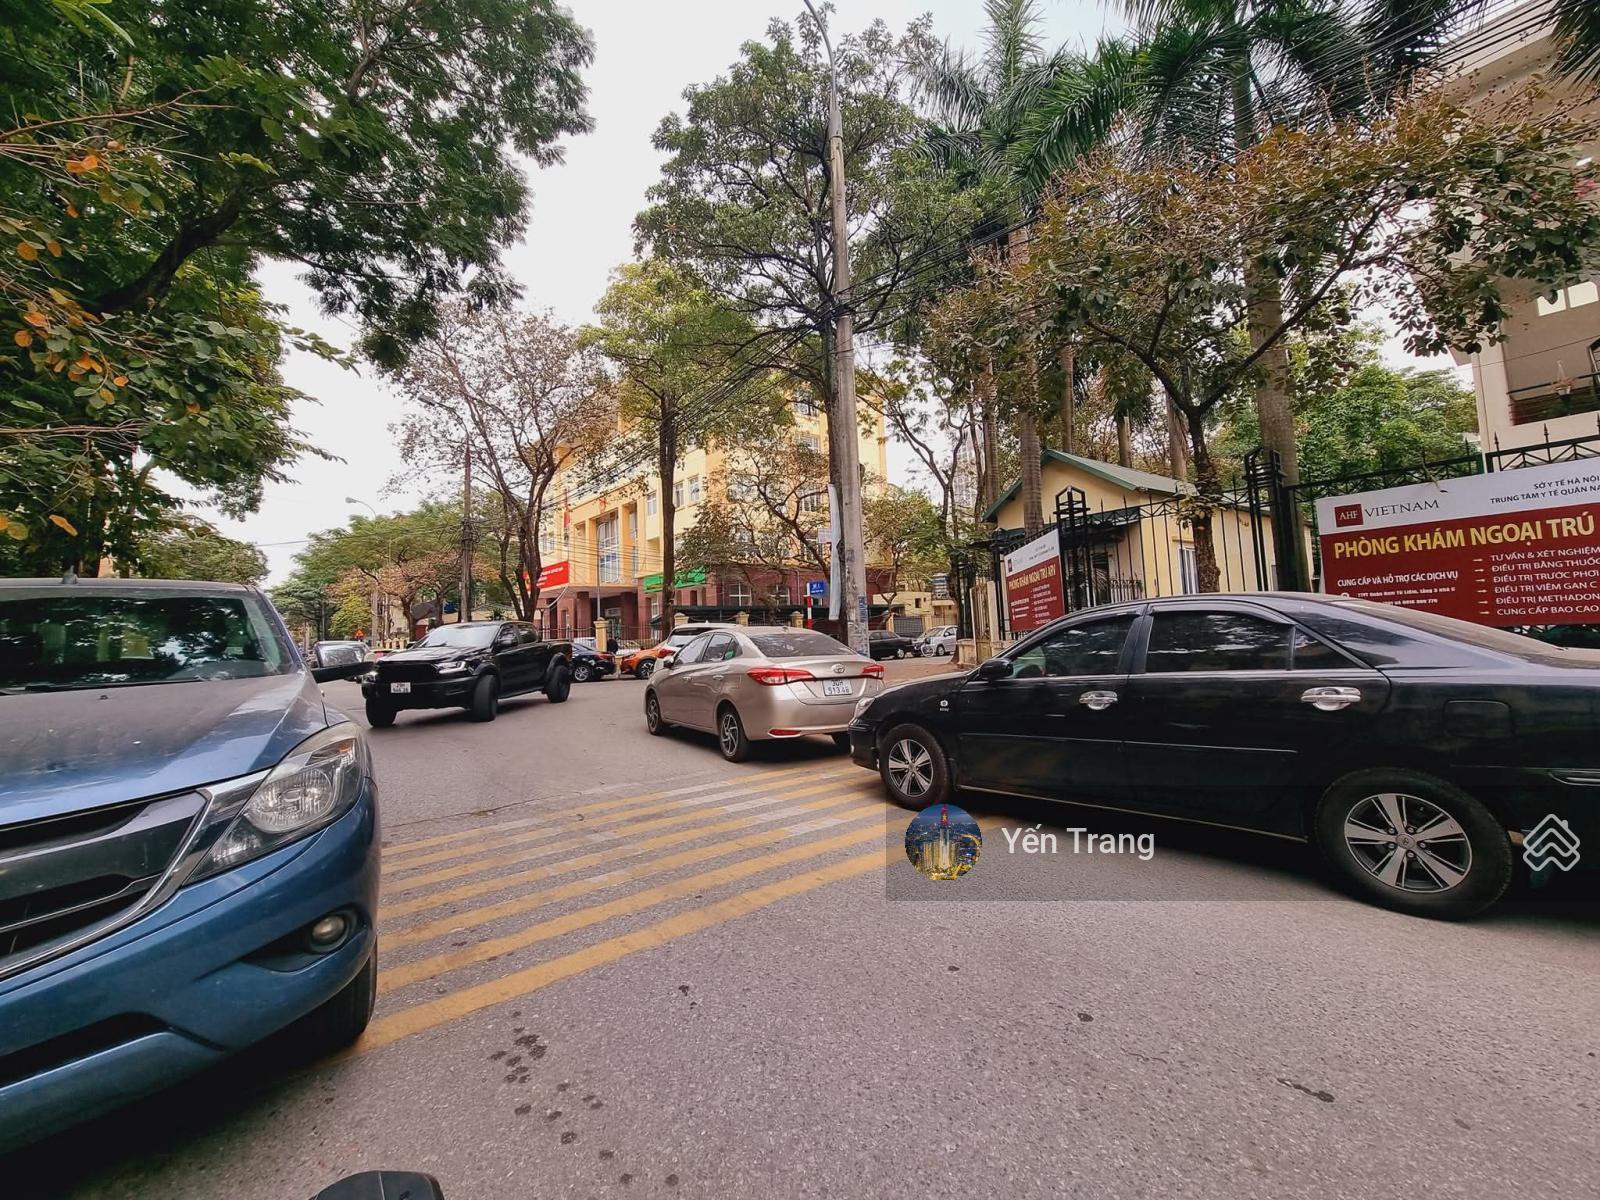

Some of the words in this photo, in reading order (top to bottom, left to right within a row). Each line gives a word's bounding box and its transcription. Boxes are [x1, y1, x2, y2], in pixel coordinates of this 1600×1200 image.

[1534, 481, 1546, 489] SỞ
[1555, 478, 1565, 487] TẾ
[1490, 494, 1520, 504] TRUNG
[1521, 491, 1540, 500] TÂM
[1541, 490, 1546, 498] Y
[1339, 510, 1358, 521] AHF
[1364, 499, 1440, 518] VIETNAM
[1334, 536, 1400, 559] PHÒNG
[1403, 527, 1466, 552] KHÁM
[1469, 521, 1543, 546] NGOẠI
[1545, 511, 1595, 540] TRÚ
[1490, 553, 1504, 562] TƯ
[1527, 551, 1535, 559] &
[1337, 578, 1357, 587] CUNG
[1563, 581, 1587, 590] GAN
[1589, 580, 1598, 588] C
[1496, 607, 1527, 616] CUNG
[1550, 605, 1574, 614] BAO
[1575, 604, 1600, 613] CAO
